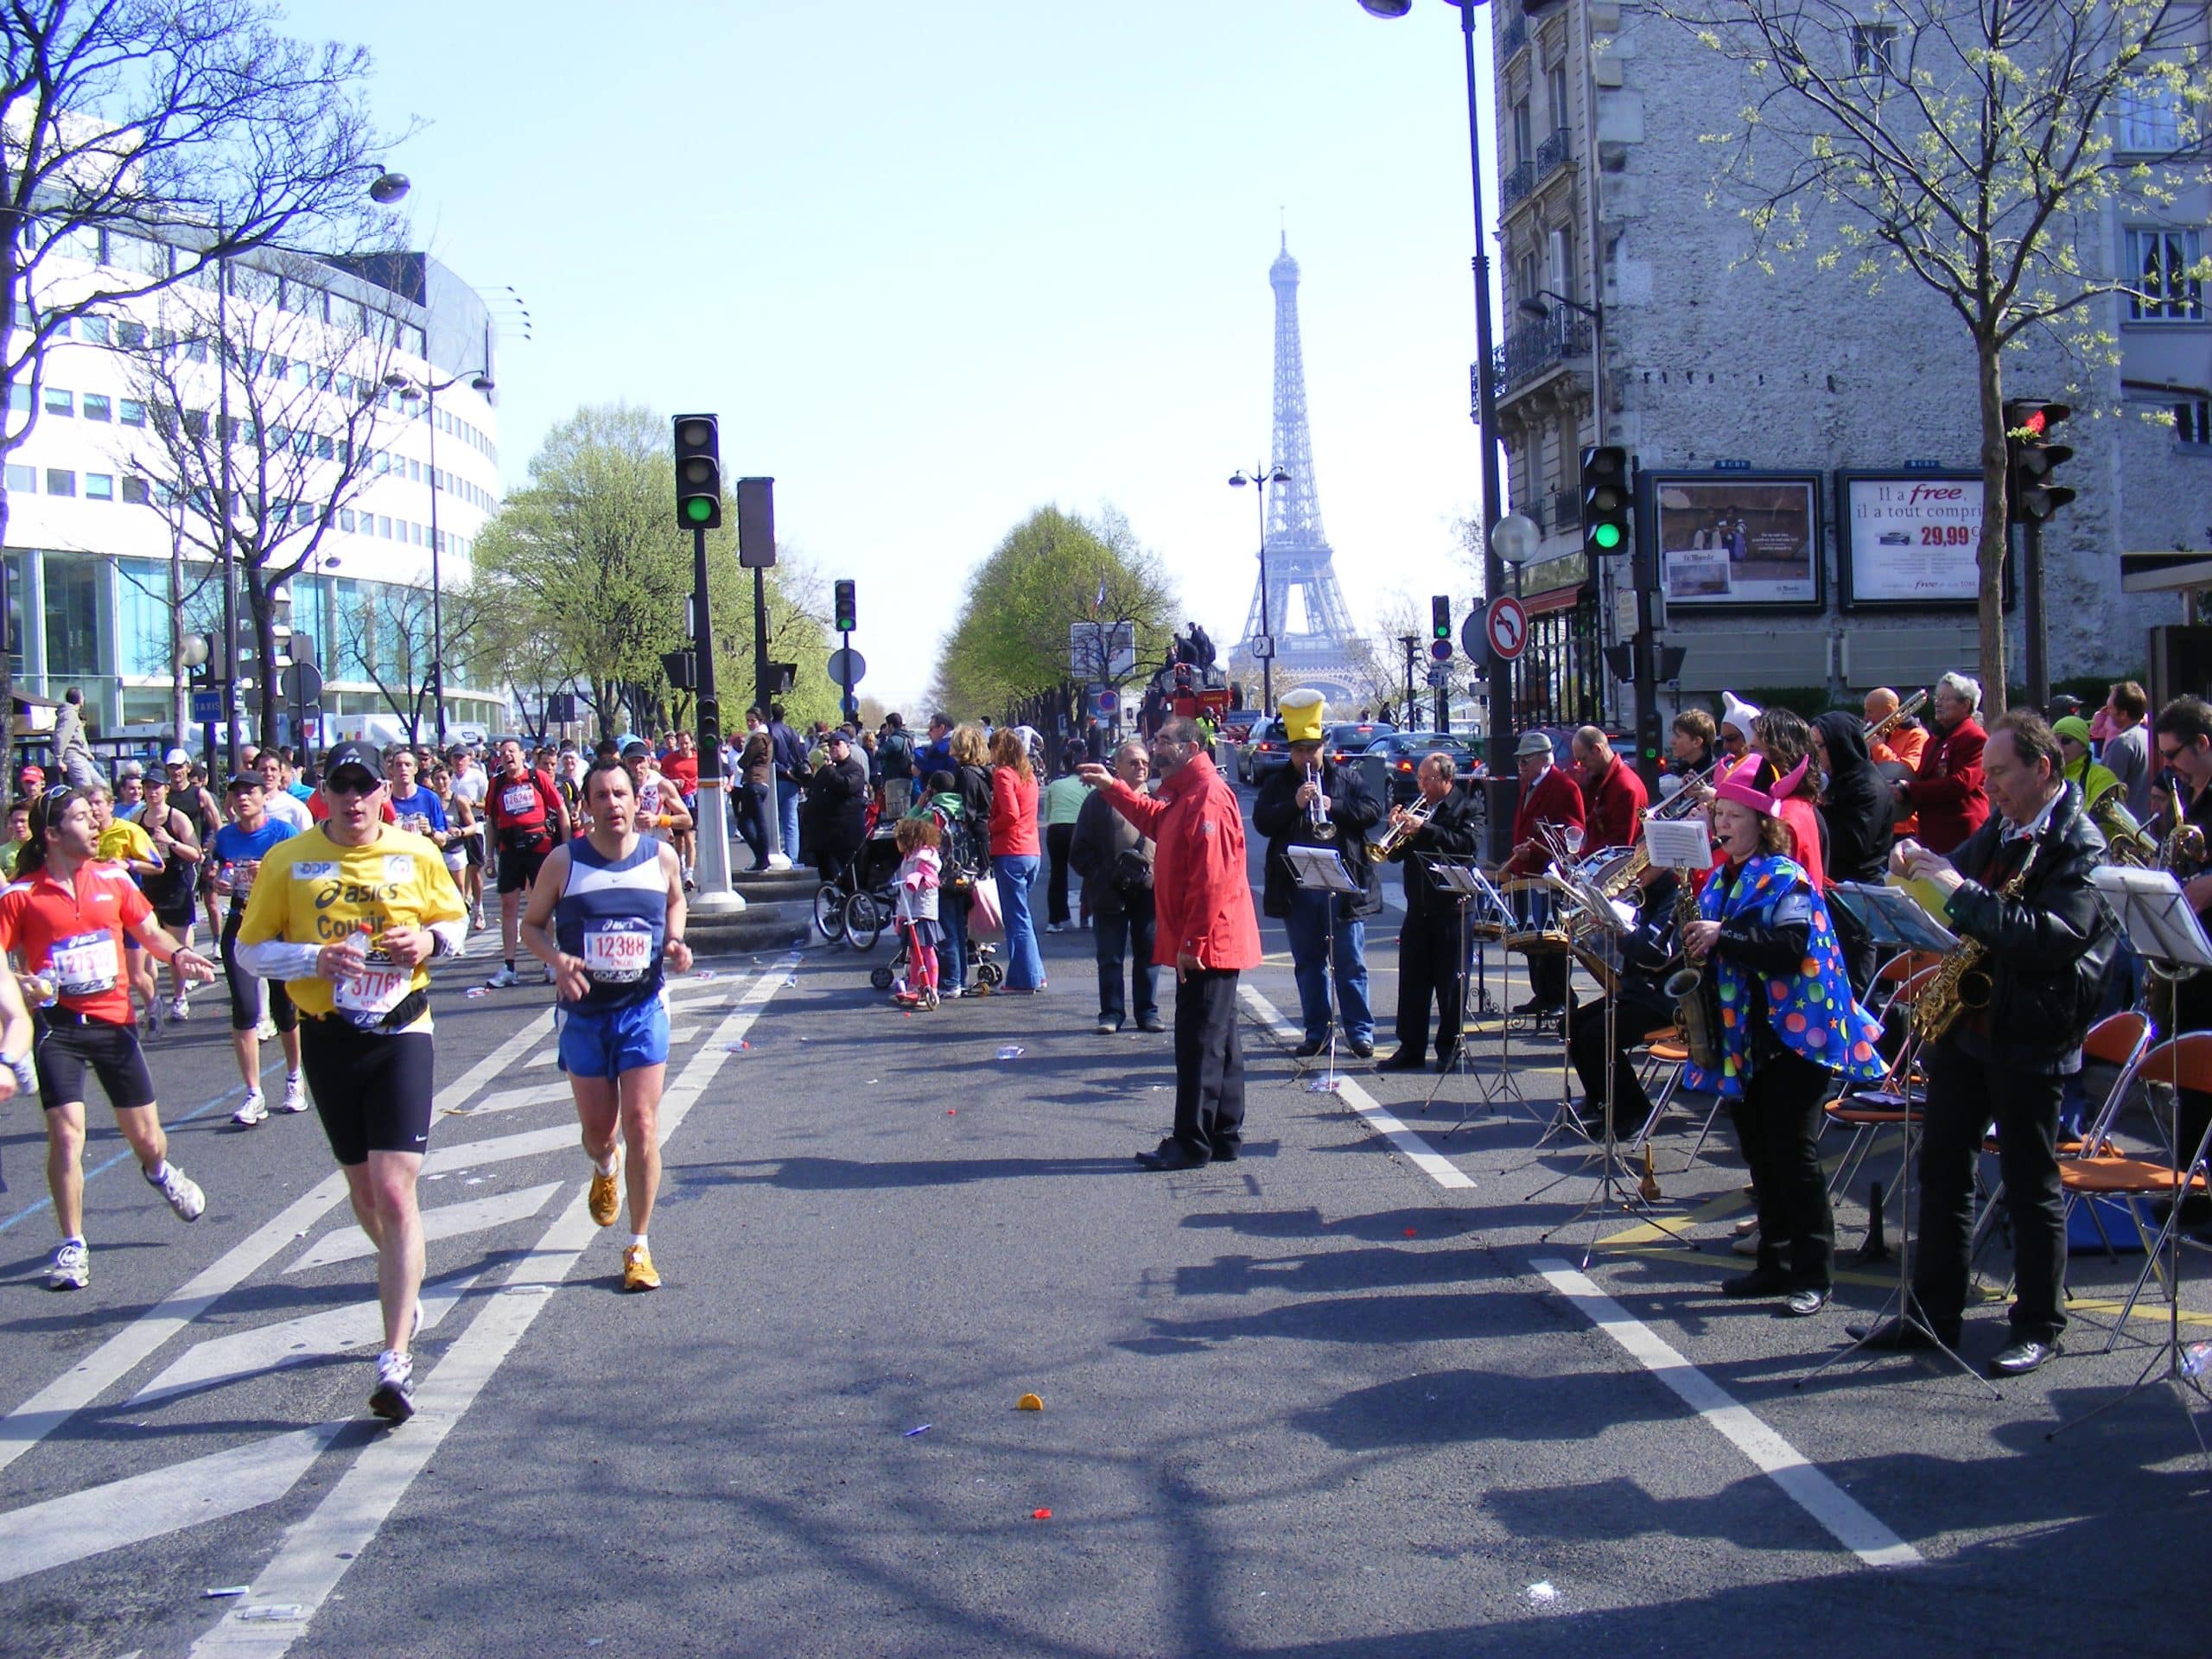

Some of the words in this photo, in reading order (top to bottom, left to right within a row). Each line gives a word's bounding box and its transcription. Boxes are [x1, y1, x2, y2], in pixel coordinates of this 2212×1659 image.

[1897, 492, 1905, 501] a
[1857, 504, 1867, 518] il
[1873, 508, 1882, 518] a
[1888, 506, 1922, 518] tout
[1927, 504, 1982, 522] compri
[1921, 525, 1969, 546] 29,99
[1915, 580, 1937, 590] free
[195, 700, 220, 712] TAXIS
[344, 883, 398, 903] asics
[596, 935, 645, 957] 12388
[351, 970, 402, 996] 37761
